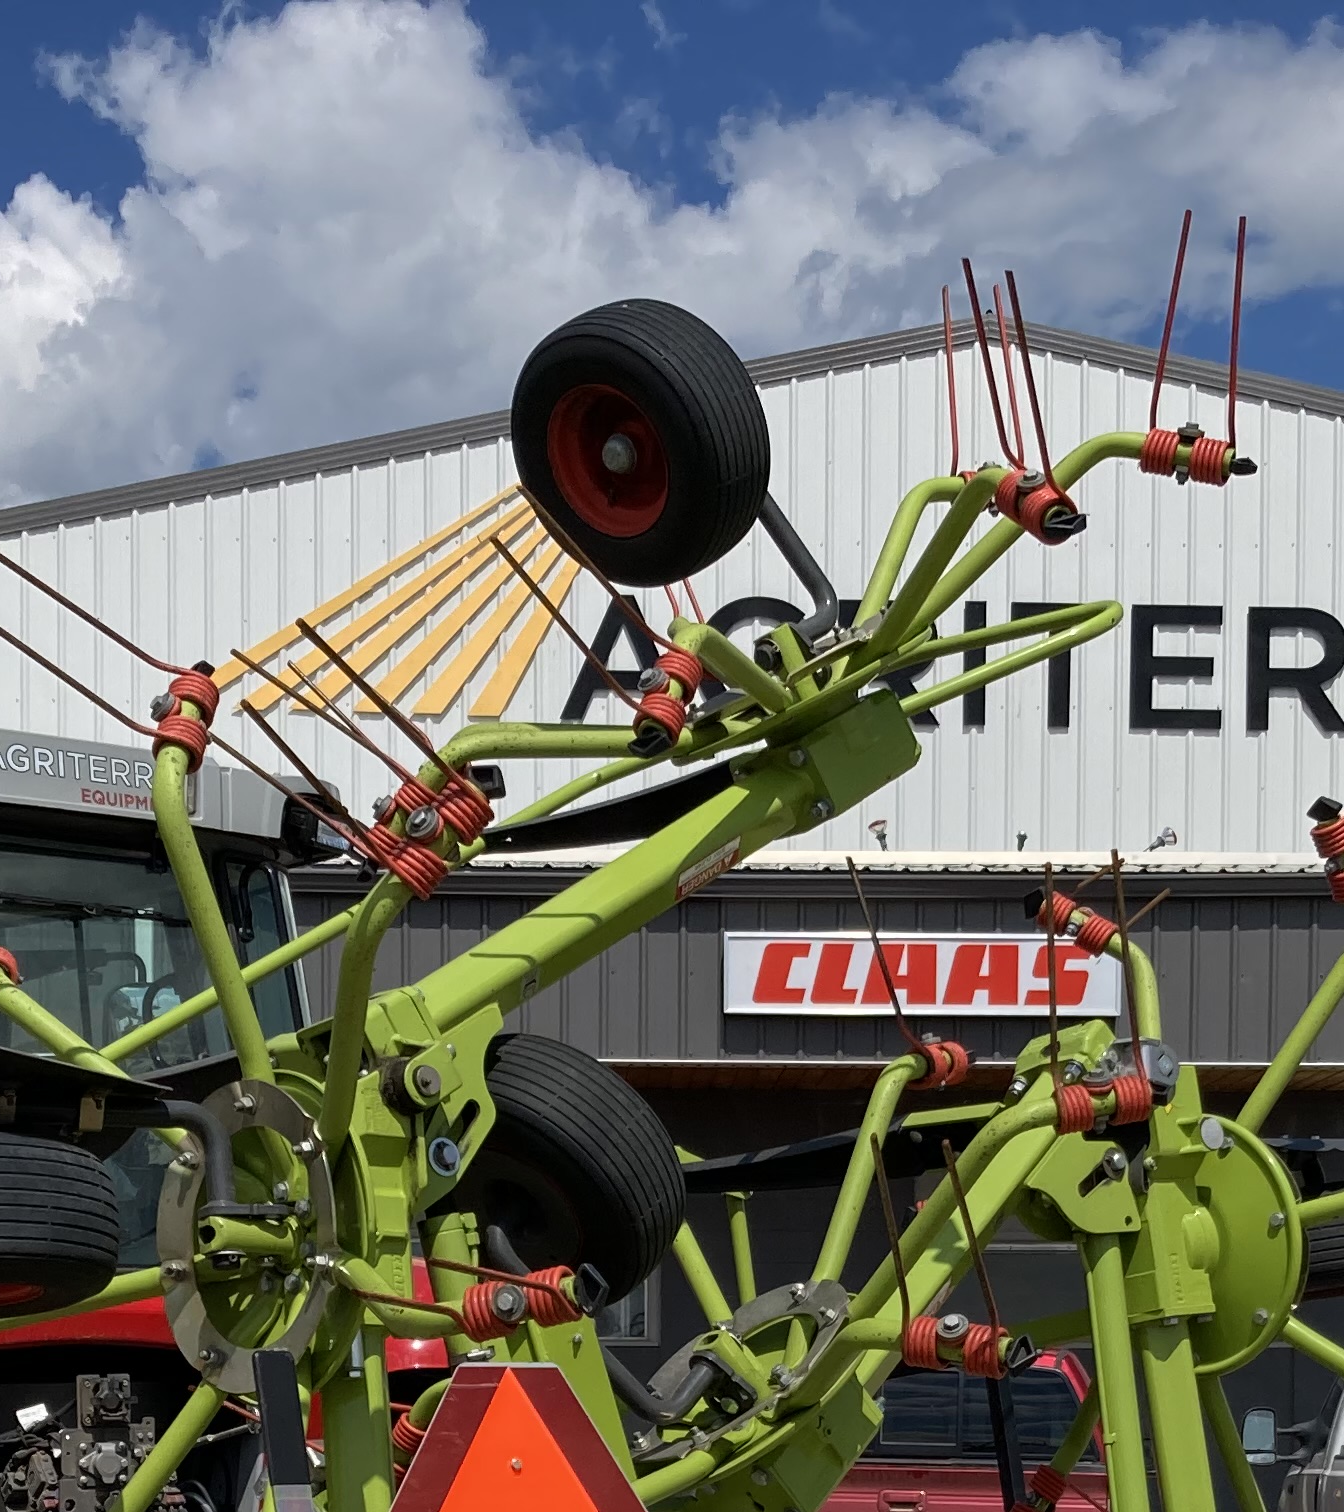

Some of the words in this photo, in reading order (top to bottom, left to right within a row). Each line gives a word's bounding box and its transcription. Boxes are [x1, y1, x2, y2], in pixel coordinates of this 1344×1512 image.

[81, 788, 153, 811] EQUIPM
[681, 860, 722, 896] DANGER
[752, 943, 1090, 1005] CLAAS
